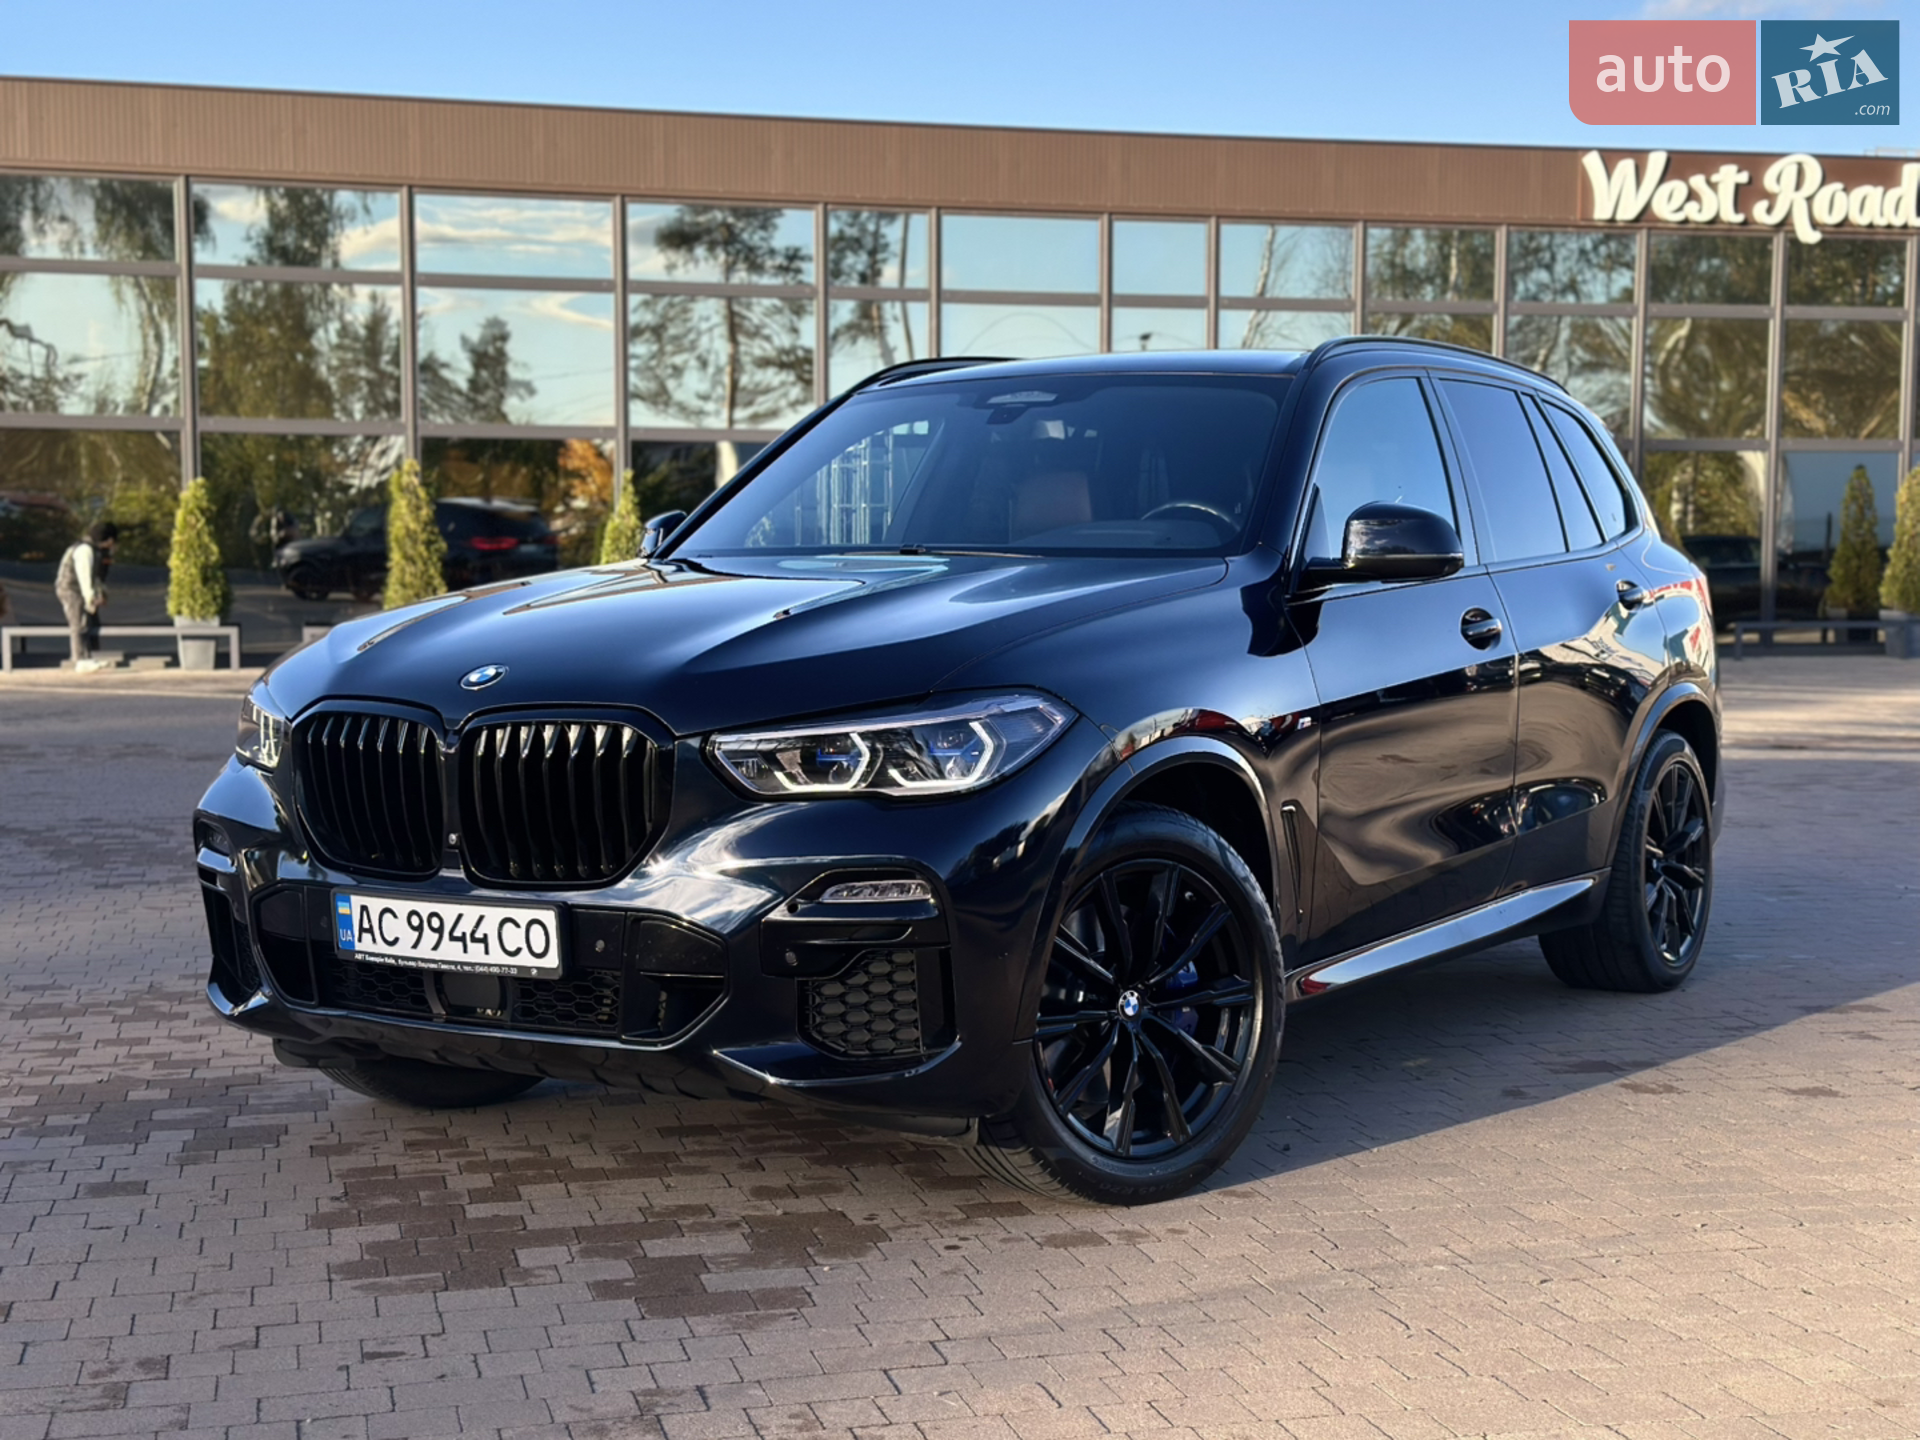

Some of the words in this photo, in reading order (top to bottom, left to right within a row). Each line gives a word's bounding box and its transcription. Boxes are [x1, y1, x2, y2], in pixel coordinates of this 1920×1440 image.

[1582, 150, 1750, 223] West
[1752, 153, 1920, 244] Road
[340, 929, 353, 942] UA
[357, 904, 400, 947] AC
[406, 909, 490, 955] 9944
[497, 916, 550, 959] CO
